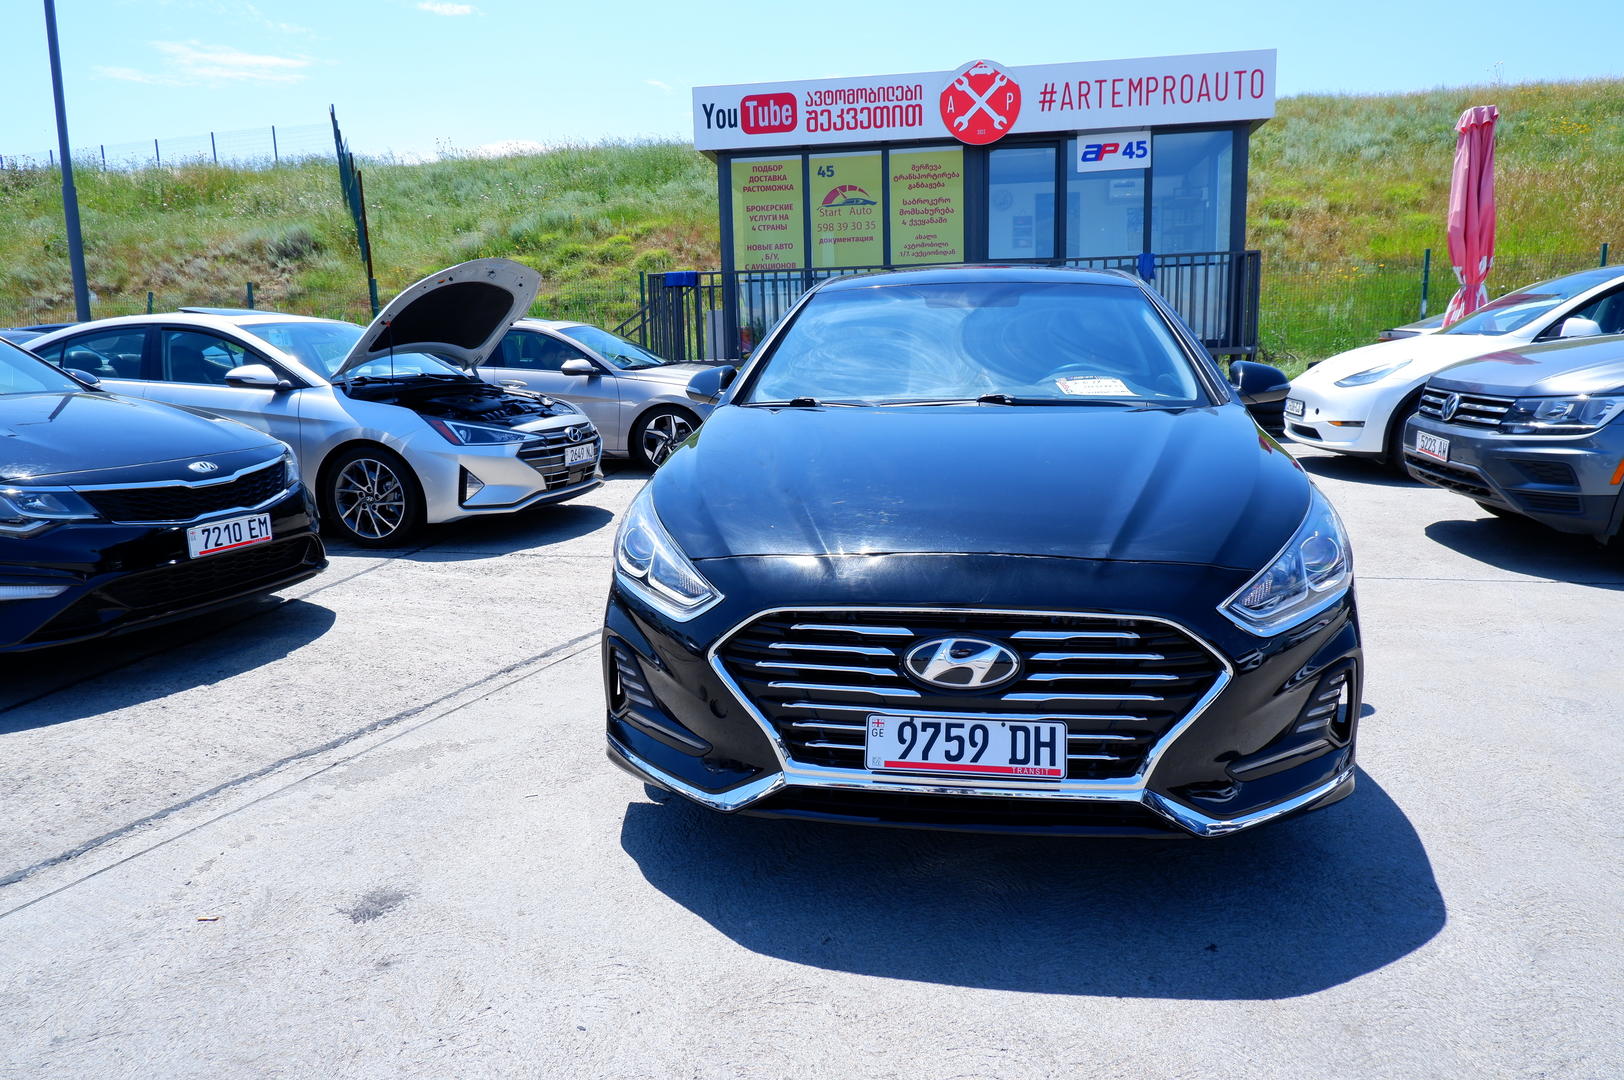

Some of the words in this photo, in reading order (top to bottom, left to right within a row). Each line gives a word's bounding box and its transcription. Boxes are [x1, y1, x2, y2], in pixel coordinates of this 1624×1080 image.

[1038, 68, 1265, 112] #ARTEMPROAUTO
[947, 95, 955, 113] A
[1006, 92, 1014, 111] P
[1122, 140, 1148, 160] 45
[752, 164, 783, 174] ПОДБОР
[816, 165, 835, 178] 45
[749, 174, 788, 184] ДОСТАВКА
[742, 184, 794, 193] РАСТОМОЖКА
[746, 203, 793, 213] БРОКЕРСКИЕ
[819, 207, 842, 218] Start
[849, 206, 873, 217] Auto
[749, 214, 778, 222] УСЛУГИ
[779, 213, 789, 221] НА
[757, 223, 788, 232] СТРАНЫ
[816, 223, 835, 233] 598
[837, 222, 849, 232] 39
[851, 221, 863, 231] 30
[865, 220, 876, 231] 35
[818, 235, 874, 245] документация
[746, 243, 774, 252] НОВЫЕ
[774, 242, 794, 251] АВТО
[751, 262, 797, 270] АУКЦИОНОВ
[201, 522, 243, 549] 7210
[248, 516, 269, 539] EM
[871, 728, 885, 738] GE
[897, 720, 990, 764] 9759
[1008, 725, 1057, 767] DH
[1011, 767, 1049, 776] TRANSIT
